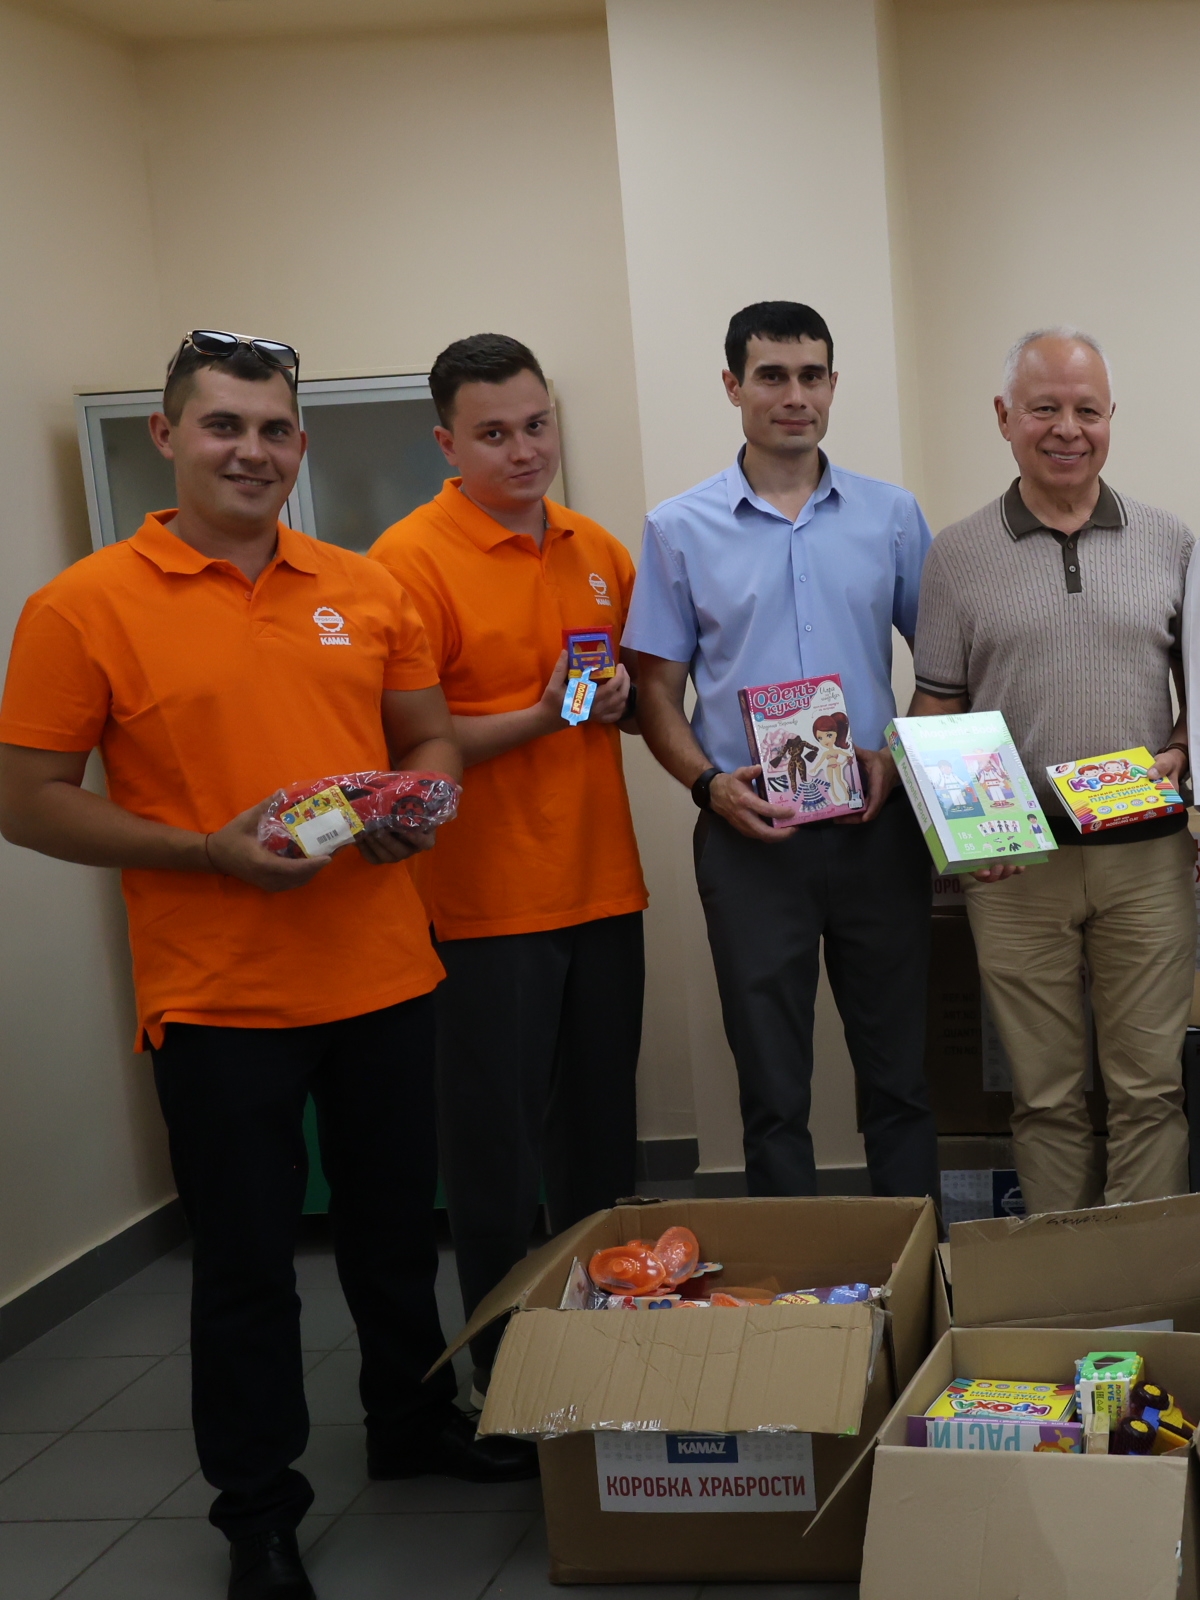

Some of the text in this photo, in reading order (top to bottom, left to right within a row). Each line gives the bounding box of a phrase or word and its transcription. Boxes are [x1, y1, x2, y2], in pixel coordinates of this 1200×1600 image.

[320, 636, 352, 646] KAMAZ
[754, 682, 816, 708] Одень
[766, 696, 812, 716] куклу
[1070, 766, 1148, 790] КРОХА
[1090, 786, 1152, 803] ПЛАСТИЛИН
[1107, 1384, 1115, 1401] КУБ
[955, 1401, 1049, 1415] КРОХА
[678, 1441, 726, 1454] KAMAZ
[606, 1475, 806, 1497] КОРОБКА ХРАБРОСТИ
